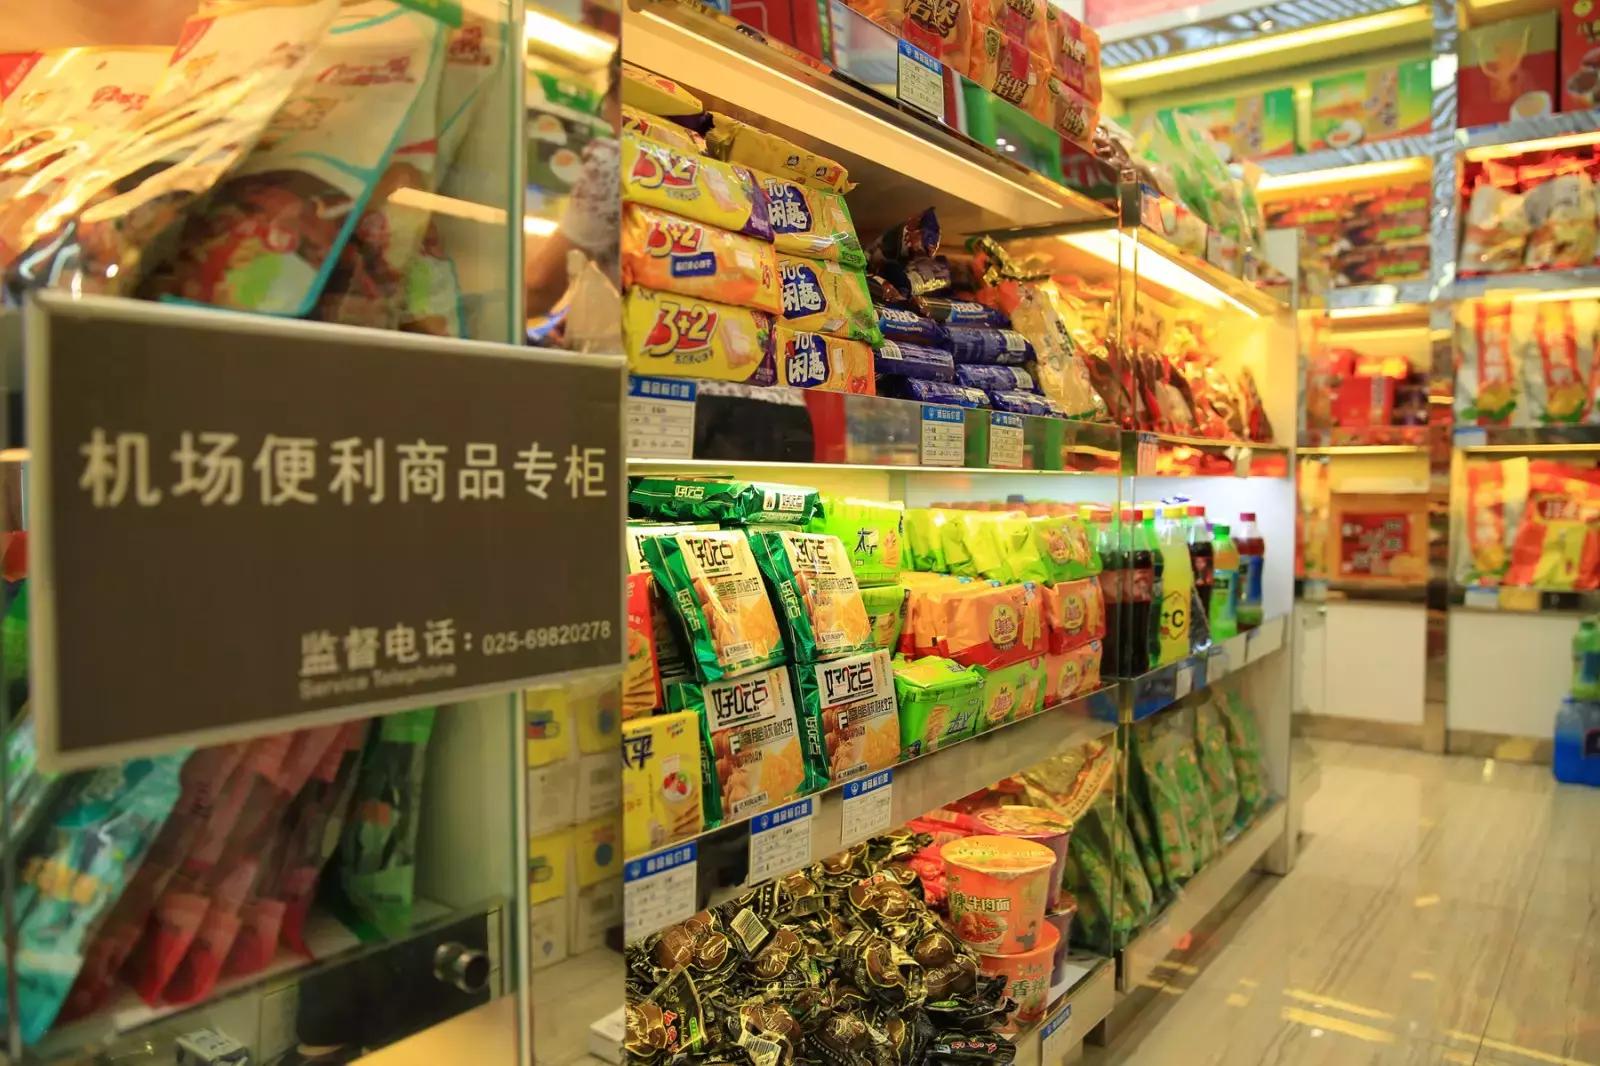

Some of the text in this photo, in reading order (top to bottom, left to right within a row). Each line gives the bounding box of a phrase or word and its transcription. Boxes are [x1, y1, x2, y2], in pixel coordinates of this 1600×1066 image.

[765, 178, 794, 198] TUC
[768, 198, 808, 229] 闲趣
[780, 260, 806, 280] TUC
[645, 301, 710, 357] 3+2
[78, 428, 608, 507] 机场便利商品专柜
[482, 620, 612, 656] 025-69820278
[824, 662, 874, 698] 好吃点
[711, 680, 768, 719] 好吃点
